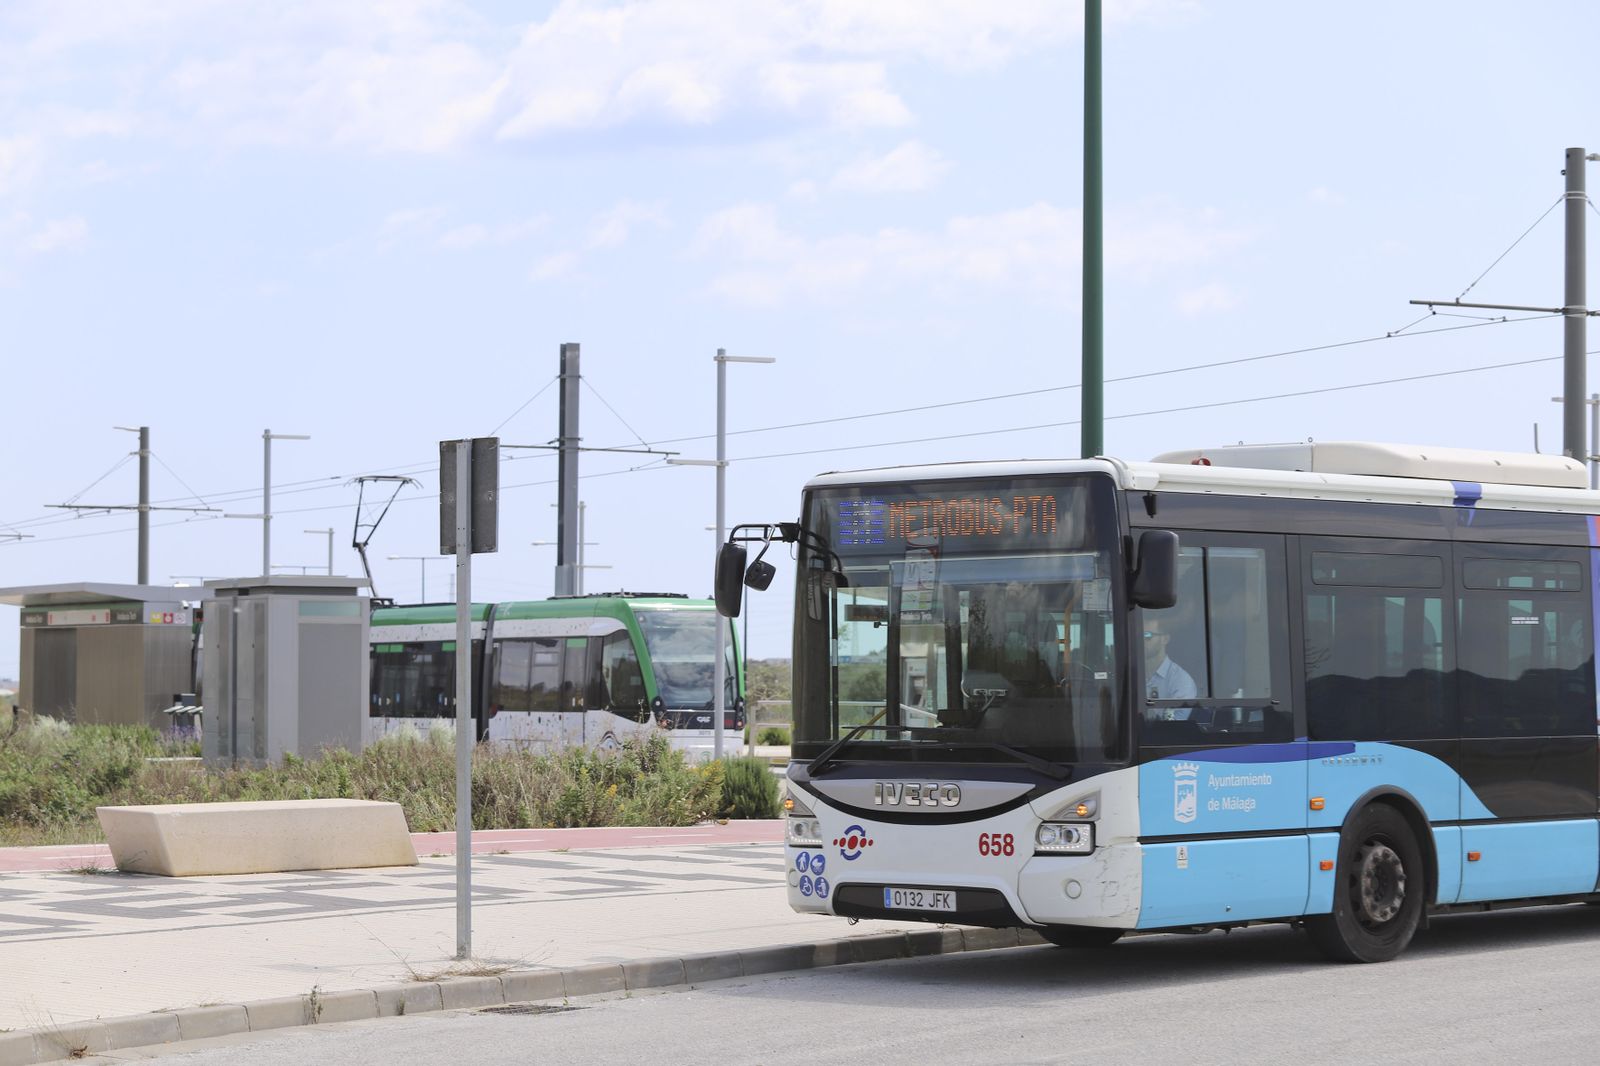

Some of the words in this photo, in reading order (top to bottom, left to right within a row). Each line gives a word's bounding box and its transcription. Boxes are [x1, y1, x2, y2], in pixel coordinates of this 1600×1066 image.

[889, 495, 1057, 538] METROBUS-PTA
[1208, 773, 1272, 790] Ayuntamiento
[874, 782, 962, 807] IVECO
[1208, 798, 1220, 811] de
[1222, 796, 1256, 812] Málaga
[978, 832, 1015, 857] 658
[894, 890, 924, 908] 0132
[928, 892, 951, 909] JFK
